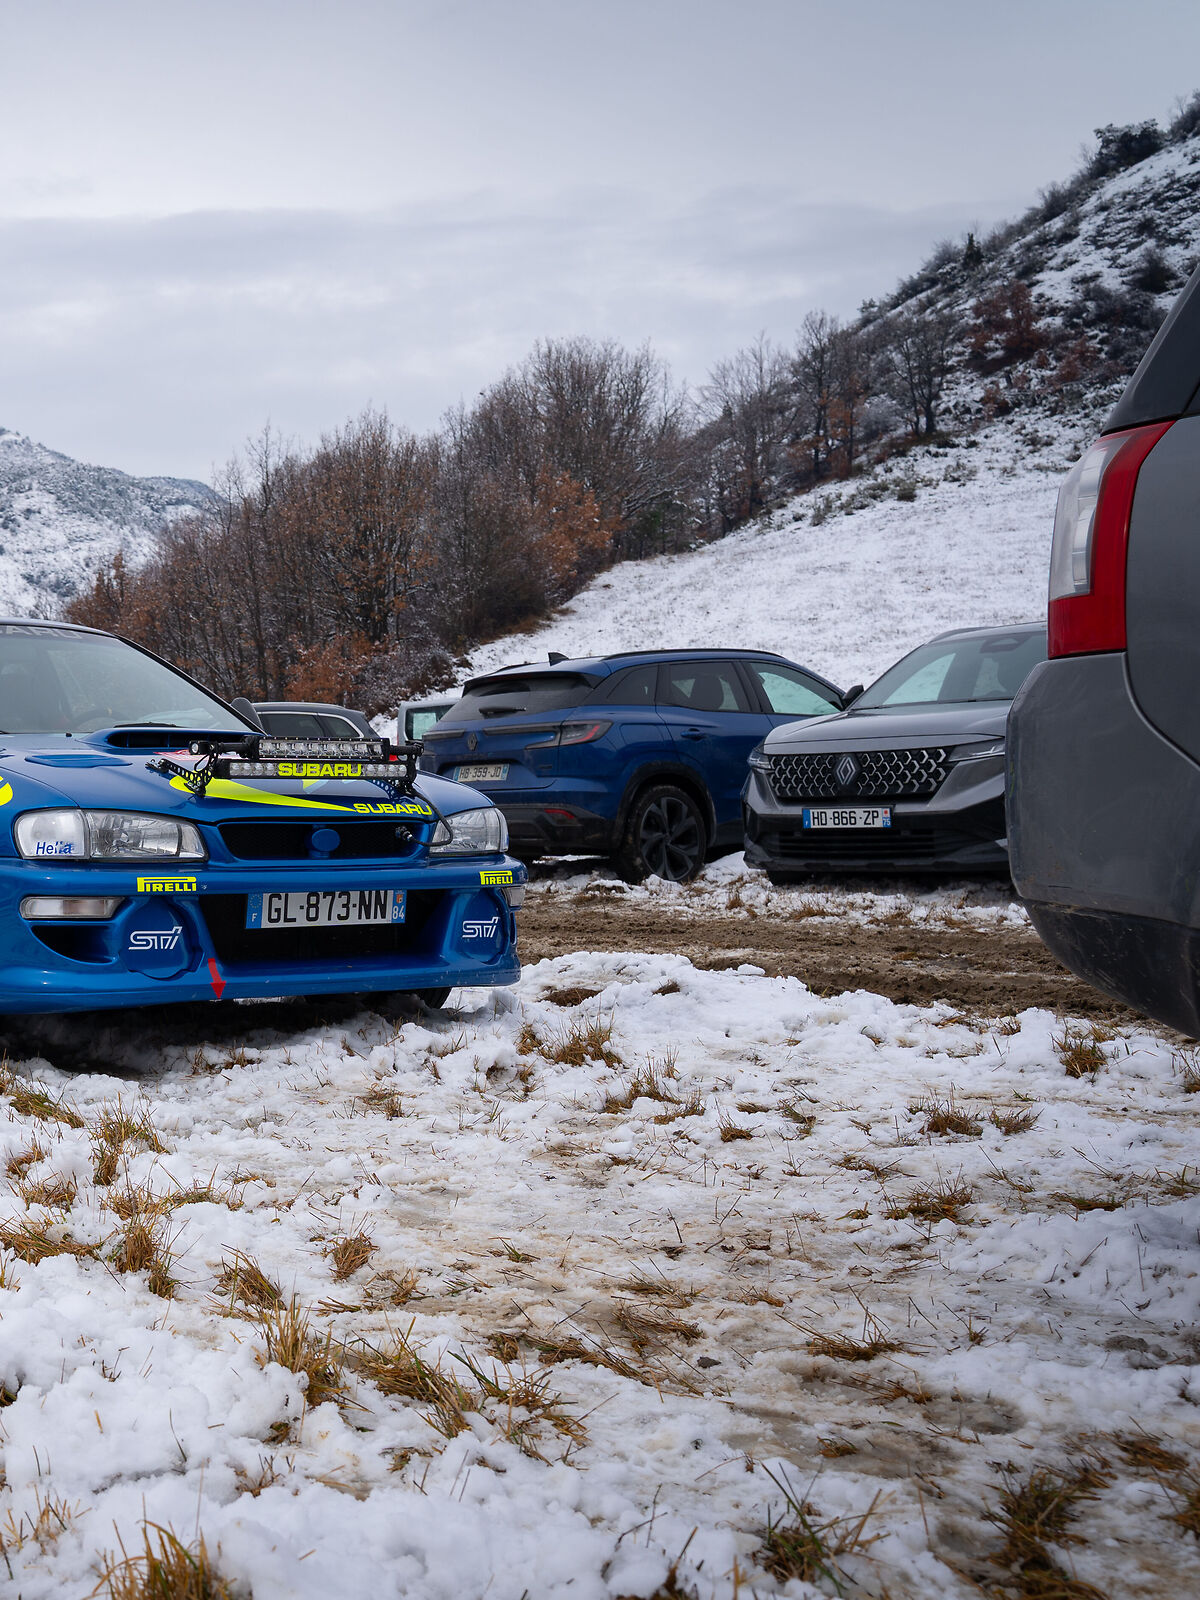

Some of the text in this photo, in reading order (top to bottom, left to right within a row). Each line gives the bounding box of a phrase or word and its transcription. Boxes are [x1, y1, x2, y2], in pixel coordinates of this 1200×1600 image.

[278, 763, 363, 777] SUBARU
[353, 803, 433, 816] SUBARU
[811, 810, 880, 826] HD-866-ZP
[136, 876, 197, 893] PIRELLI
[480, 870, 513, 885] PIRELLI
[267, 890, 388, 924] GL-873-NN
[392, 905, 405, 920] 84
[251, 913, 258, 922] F
